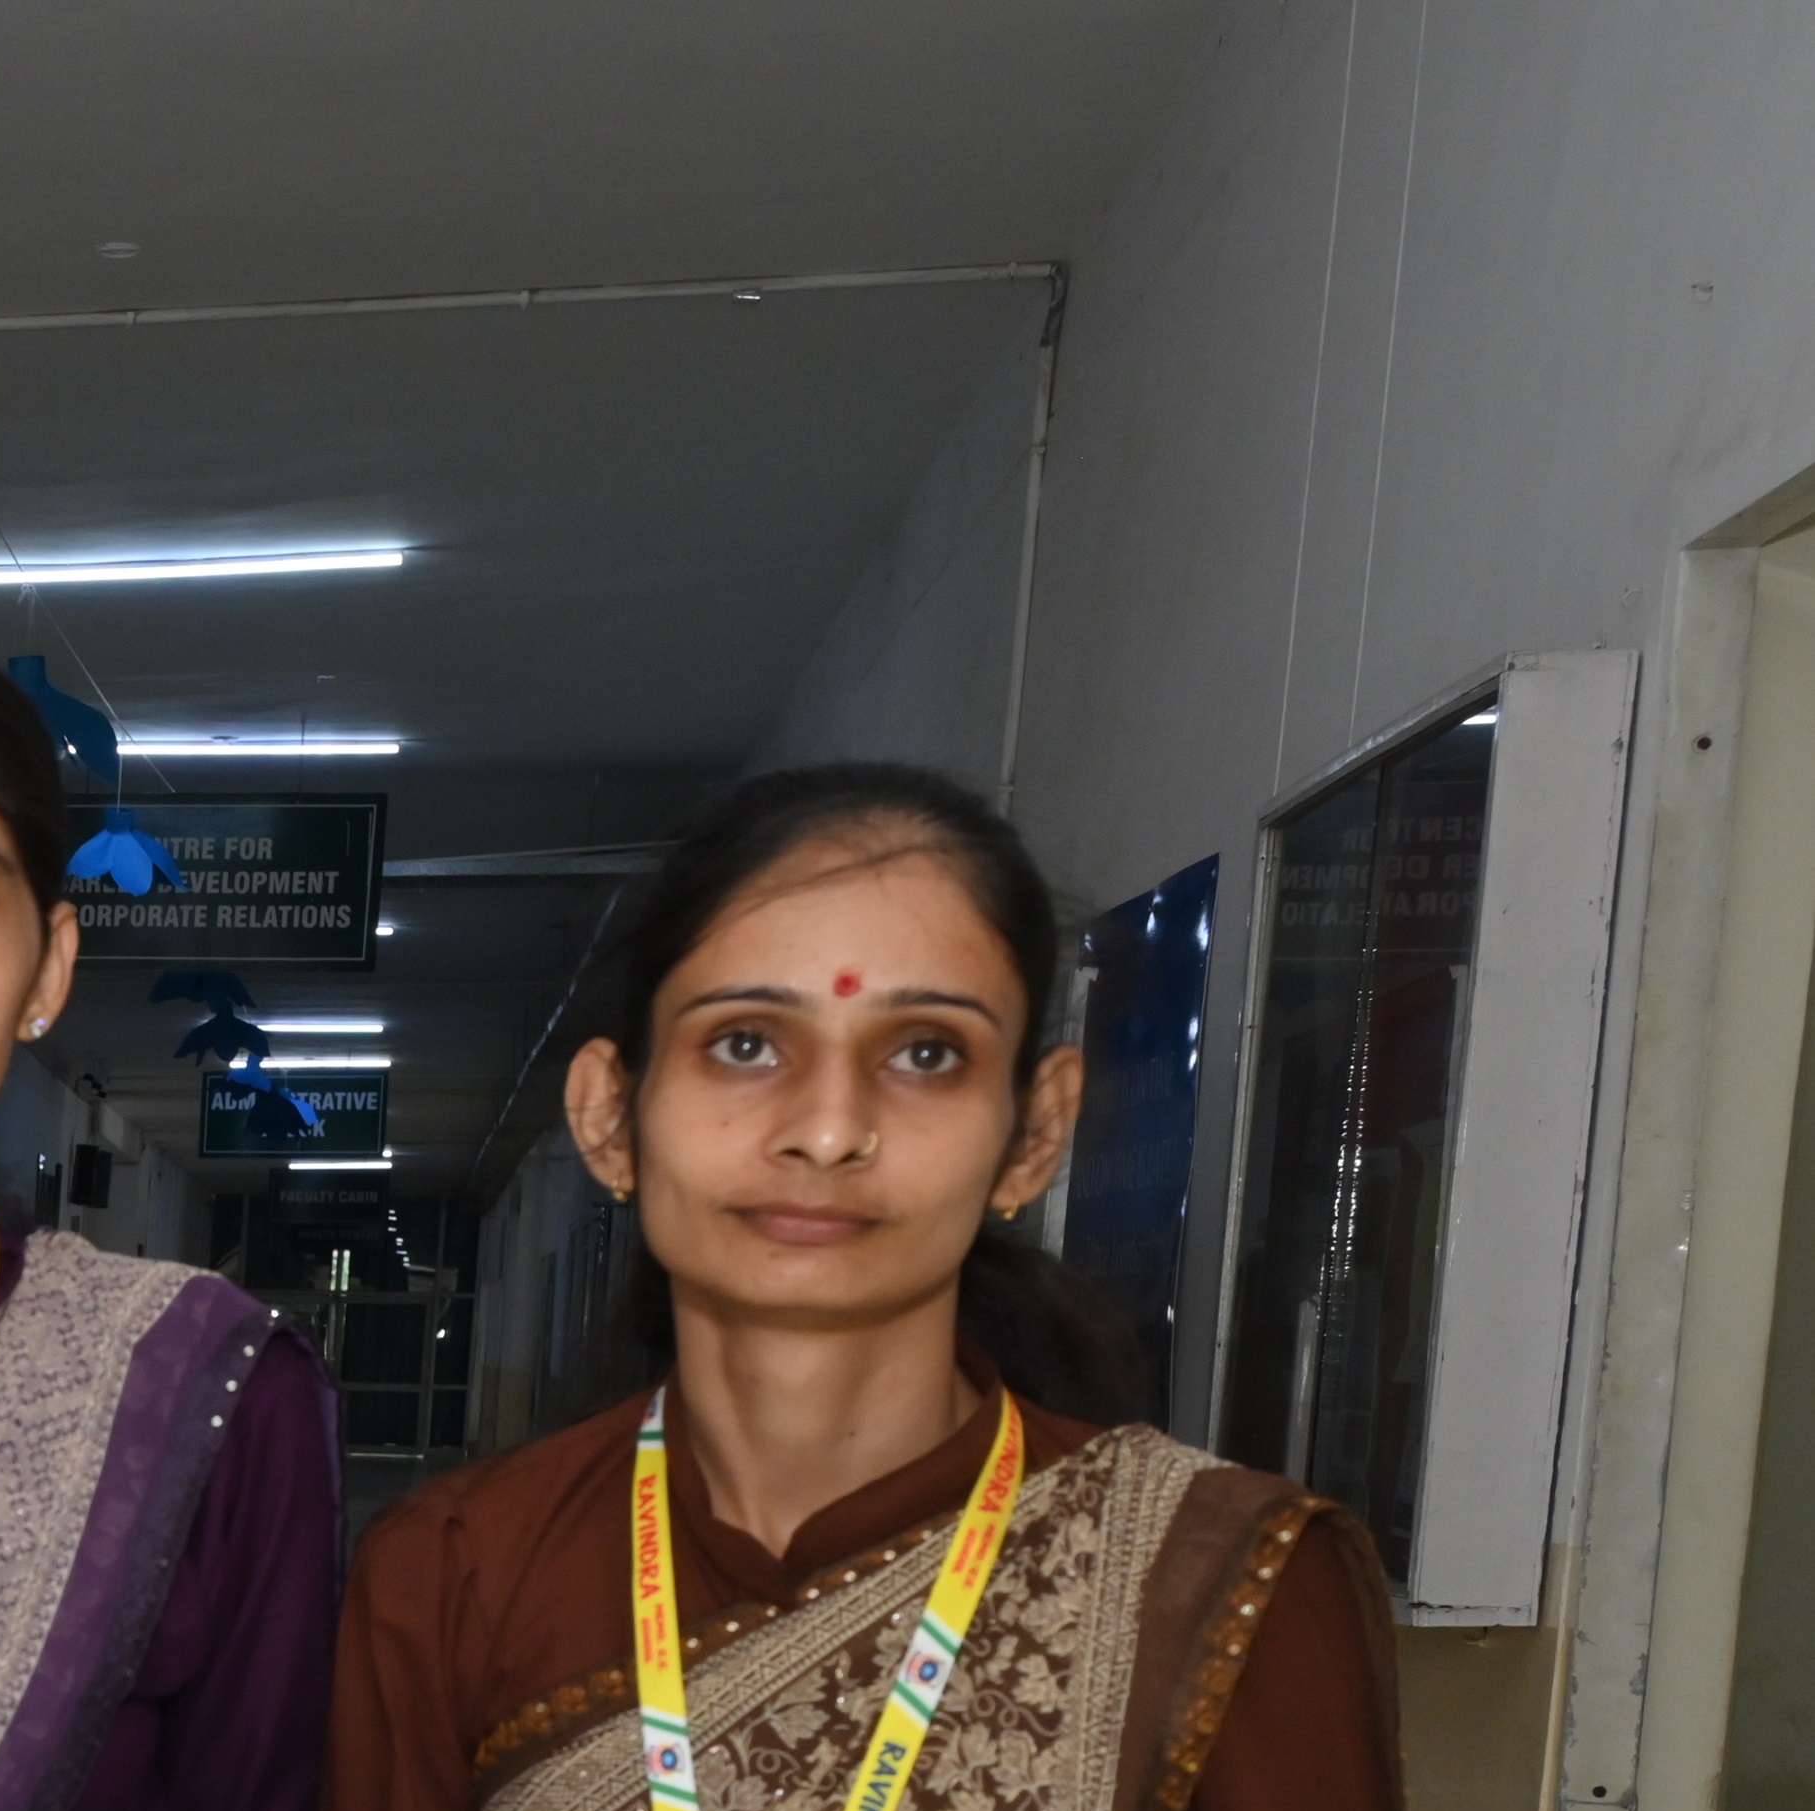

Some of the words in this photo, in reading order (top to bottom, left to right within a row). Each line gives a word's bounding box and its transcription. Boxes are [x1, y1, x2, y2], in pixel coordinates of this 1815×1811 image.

[225, 837, 274, 861] FOR
[79, 904, 208, 928] ORPORATE
[217, 904, 352, 928] RELATIONS
[280, 1190, 336, 1203] FACULTY
[638, 1473, 662, 1600] RAVINDRA
